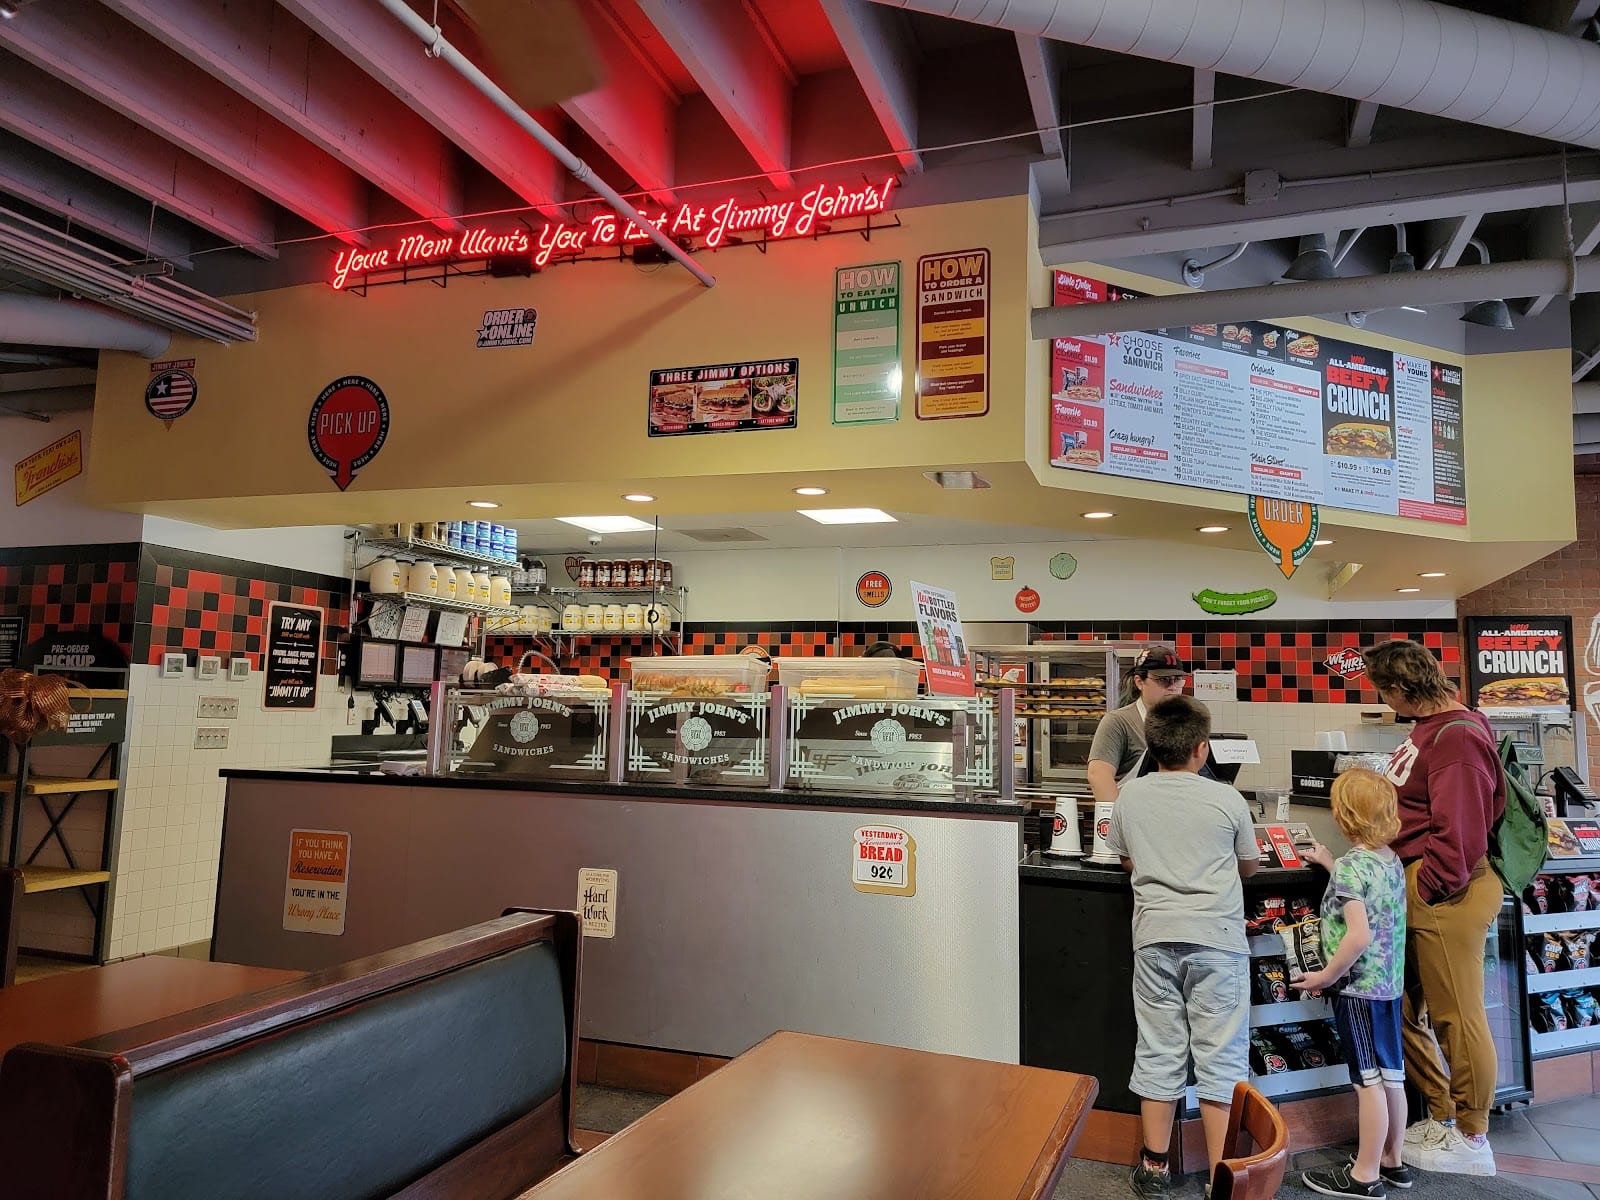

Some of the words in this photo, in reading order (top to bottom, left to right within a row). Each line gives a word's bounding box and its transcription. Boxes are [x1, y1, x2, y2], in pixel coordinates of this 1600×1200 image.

[334, 249, 388, 289] Your
[397, 235, 452, 262] Mom
[460, 229, 529, 254] Wants
[535, 223, 587, 265] You
[591, 215, 615, 242] To
[672, 204, 706, 232] At
[706, 198, 794, 247] Jimmy
[795, 177, 895, 235] John's!
[924, 256, 983, 281] HOW
[839, 267, 895, 290] HOW
[939, 279, 971, 287] ORDER
[857, 289, 877, 297] EAT
[924, 288, 983, 303] SANDWICH
[839, 298, 896, 313] UNWICH
[484, 309, 525, 326] ORDER
[489, 322, 535, 340] ONLINE
[1056, 339, 1081, 352] Original
[1122, 335, 1163, 352] CHOOSE
[1124, 345, 1163, 361] YOUR
[1123, 355, 1163, 372] SANDWICH
[1250, 362, 1275, 376] Originals
[1329, 358, 1386, 376] ALL-AMERICAN
[1407, 360, 1421, 369] MAKE
[659, 371, 693, 383] THREE
[697, 367, 736, 380] JIMMY
[740, 363, 790, 377] OPTIONS
[1327, 365, 1389, 393] BEEFY
[1408, 368, 1428, 377] YOURS
[321, 386, 335, 401] HERE
[366, 383, 379, 397] HERE
[1109, 378, 1163, 400] Sandwiches
[1327, 383, 1390, 421] CRUNCH
[1055, 403, 1081, 417] Favorite
[321, 412, 353, 435] PICK
[358, 410, 376, 433] UP
[1109, 429, 1128, 442] Crazy
[1130, 432, 1154, 447] hungry?
[1250, 452, 1267, 463] Plain
[1264, 498, 1303, 524] ORDER
[865, 580, 883, 588] FREE
[863, 590, 885, 598] SMELLS
[929, 597, 955, 610] BOTTLED
[919, 603, 958, 623] FLAVORS
[281, 617, 295, 629] TRY
[295, 619, 312, 632] ANY
[51, 644, 90, 654] PRE-ORDER
[1478, 636, 1563, 650] BEEFY
[43, 655, 95, 667] PICKUP
[1329, 653, 1345, 665] WE
[1479, 650, 1564, 673] CRUNCH
[269, 686, 294, 698] "JIMMY
[293, 687, 301, 698] IT
[300, 687, 314, 698] UP"
[527, 697, 572, 717] JOHN'S
[647, 702, 696, 724] JIMMY
[699, 702, 749, 725] JOHN'S
[833, 702, 886, 725] JIMMY
[891, 703, 945, 727] JOHN'S
[493, 743, 554, 756] SANDWICHES
[662, 751, 730, 765] SANDWICHES
[1300, 779, 1324, 788] COOKIES
[861, 830, 904, 840] YESTERDAY'S
[296, 839, 303, 847] IF
[305, 839, 319, 849] YOU
[322, 840, 344, 849] THINK
[298, 850, 312, 859] YOU
[314, 851, 333, 860] HAVE
[334, 852, 340, 860] A
[860, 845, 903, 862] BREAD
[293, 861, 343, 877] Reservation
[871, 865, 893, 879] 92¢
[292, 887, 315, 898] YOU'RE
[317, 891, 325, 899] IN
[327, 891, 341, 900] THE
[583, 886, 608, 905] Hard
[288, 904, 315, 920] Wrong
[316, 906, 341, 920] Place
[583, 905, 612, 922] Work
[589, 921, 608, 929] BETTER
